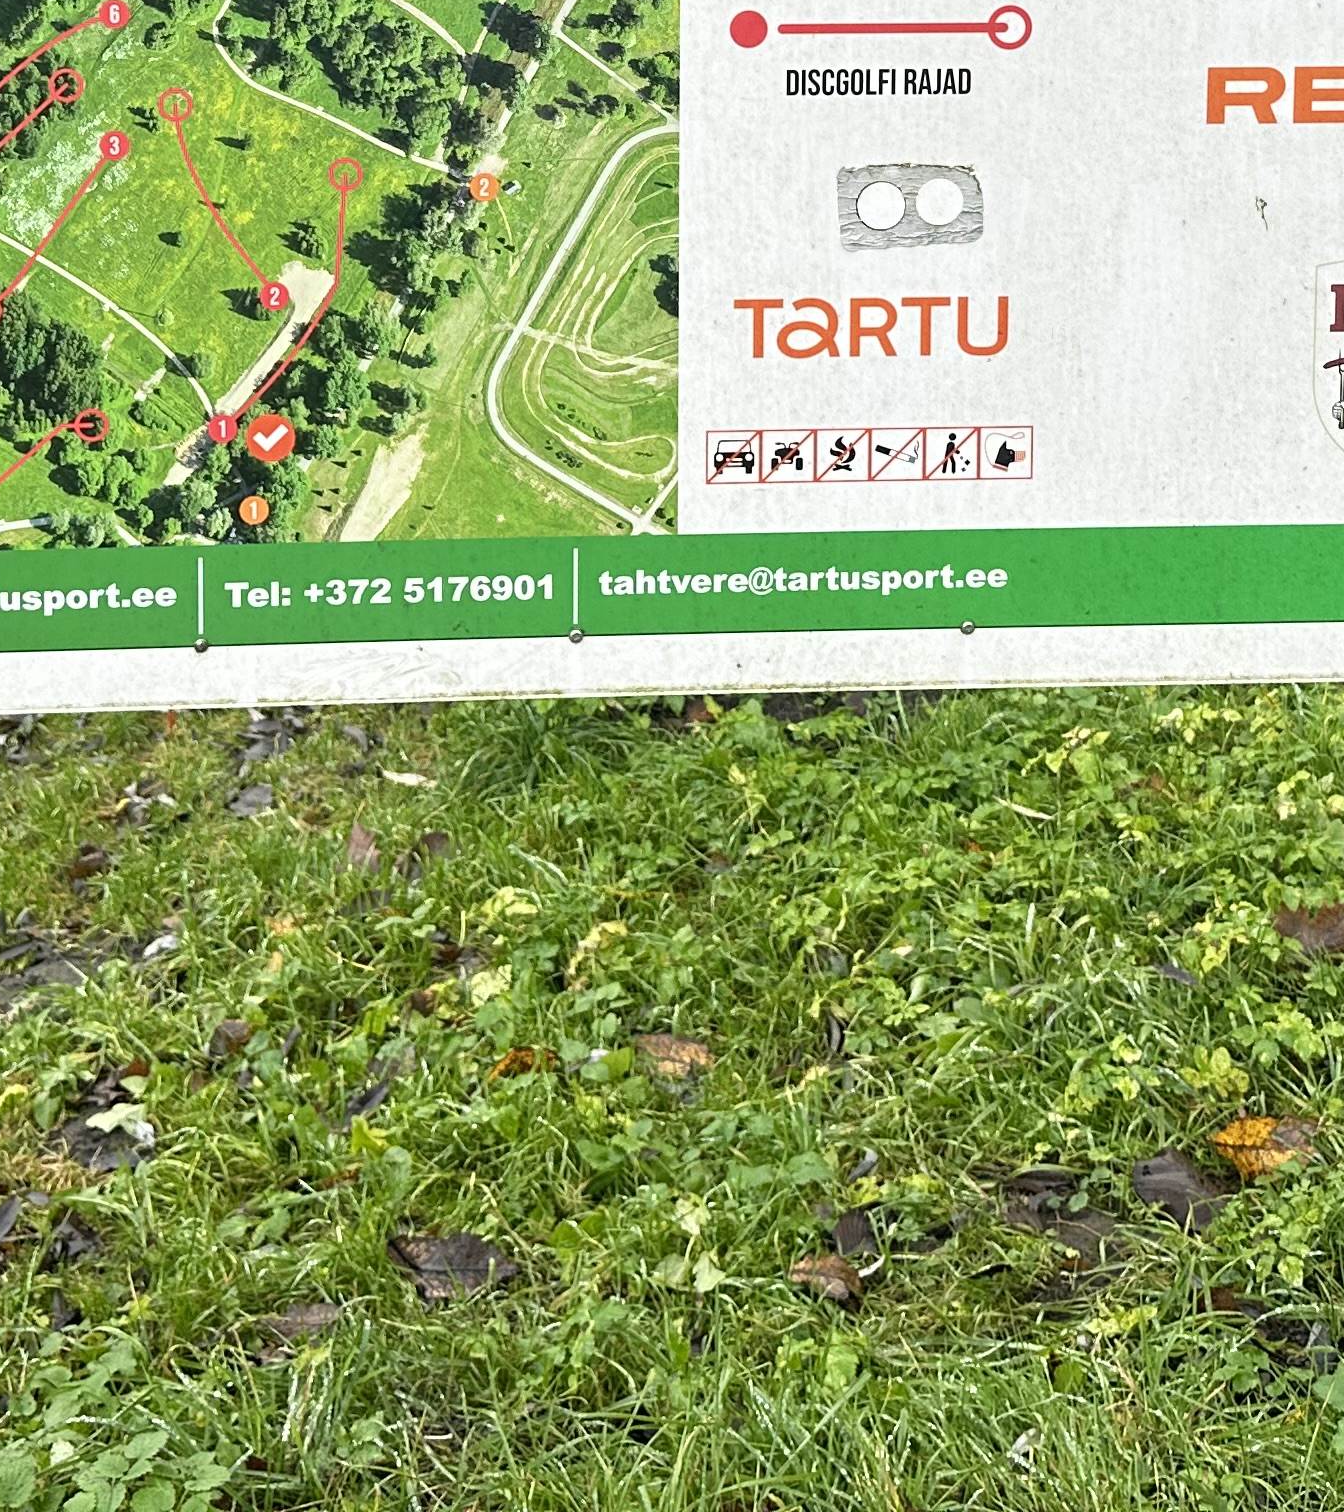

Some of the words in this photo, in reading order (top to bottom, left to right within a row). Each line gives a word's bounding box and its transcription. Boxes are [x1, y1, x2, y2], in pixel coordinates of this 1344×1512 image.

[786, 68, 896, 96] DISCGOLFI
[904, 68, 972, 95] RAJAD
[224, 581, 291, 608] Tel:
[303, 577, 392, 606] +372
[403, 573, 553, 604] 5176901
[598, 563, 1009, 596] tahtvere@tartusport.ee
